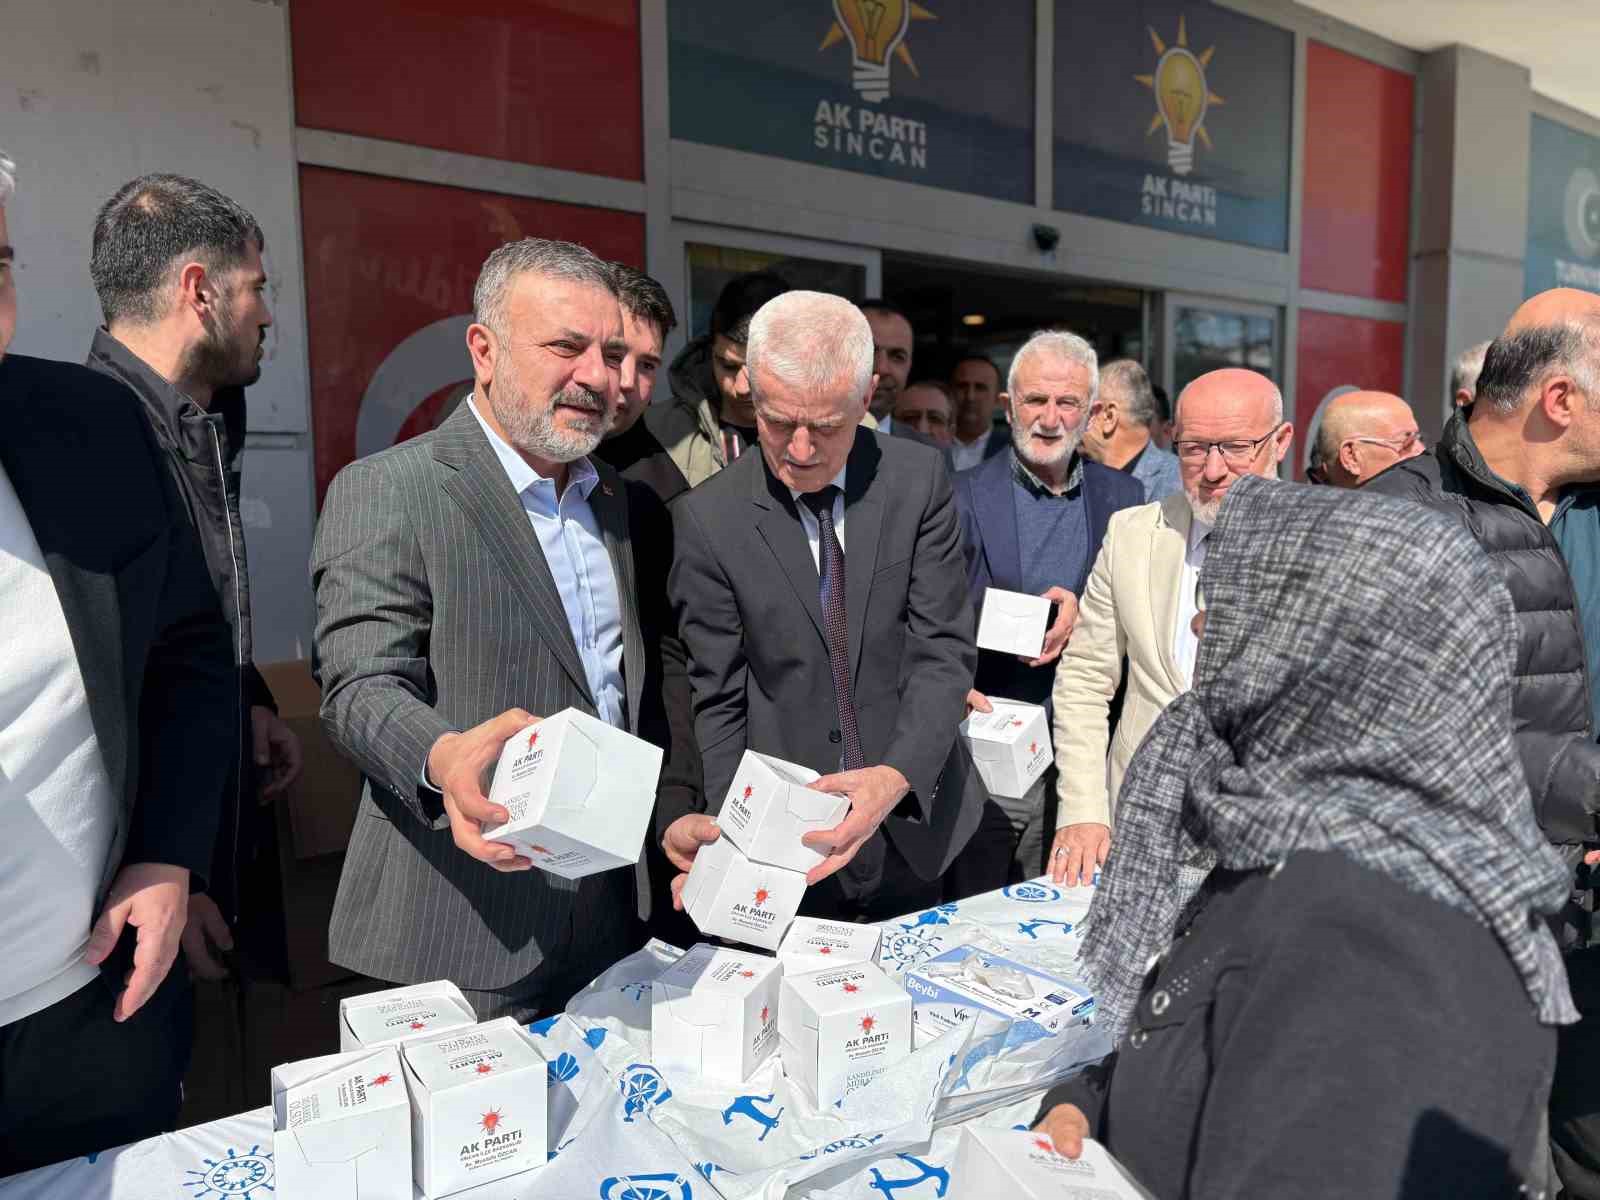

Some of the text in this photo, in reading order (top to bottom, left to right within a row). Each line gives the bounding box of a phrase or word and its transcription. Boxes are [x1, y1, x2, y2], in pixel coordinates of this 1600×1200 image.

[815, 101, 851, 129] AK
[1142, 174, 1168, 197] AK
[733, 903, 748, 914] AK
[907, 977, 939, 1000] Beybi
[845, 1039, 861, 1049] AK
[460, 1141, 480, 1157] AK
